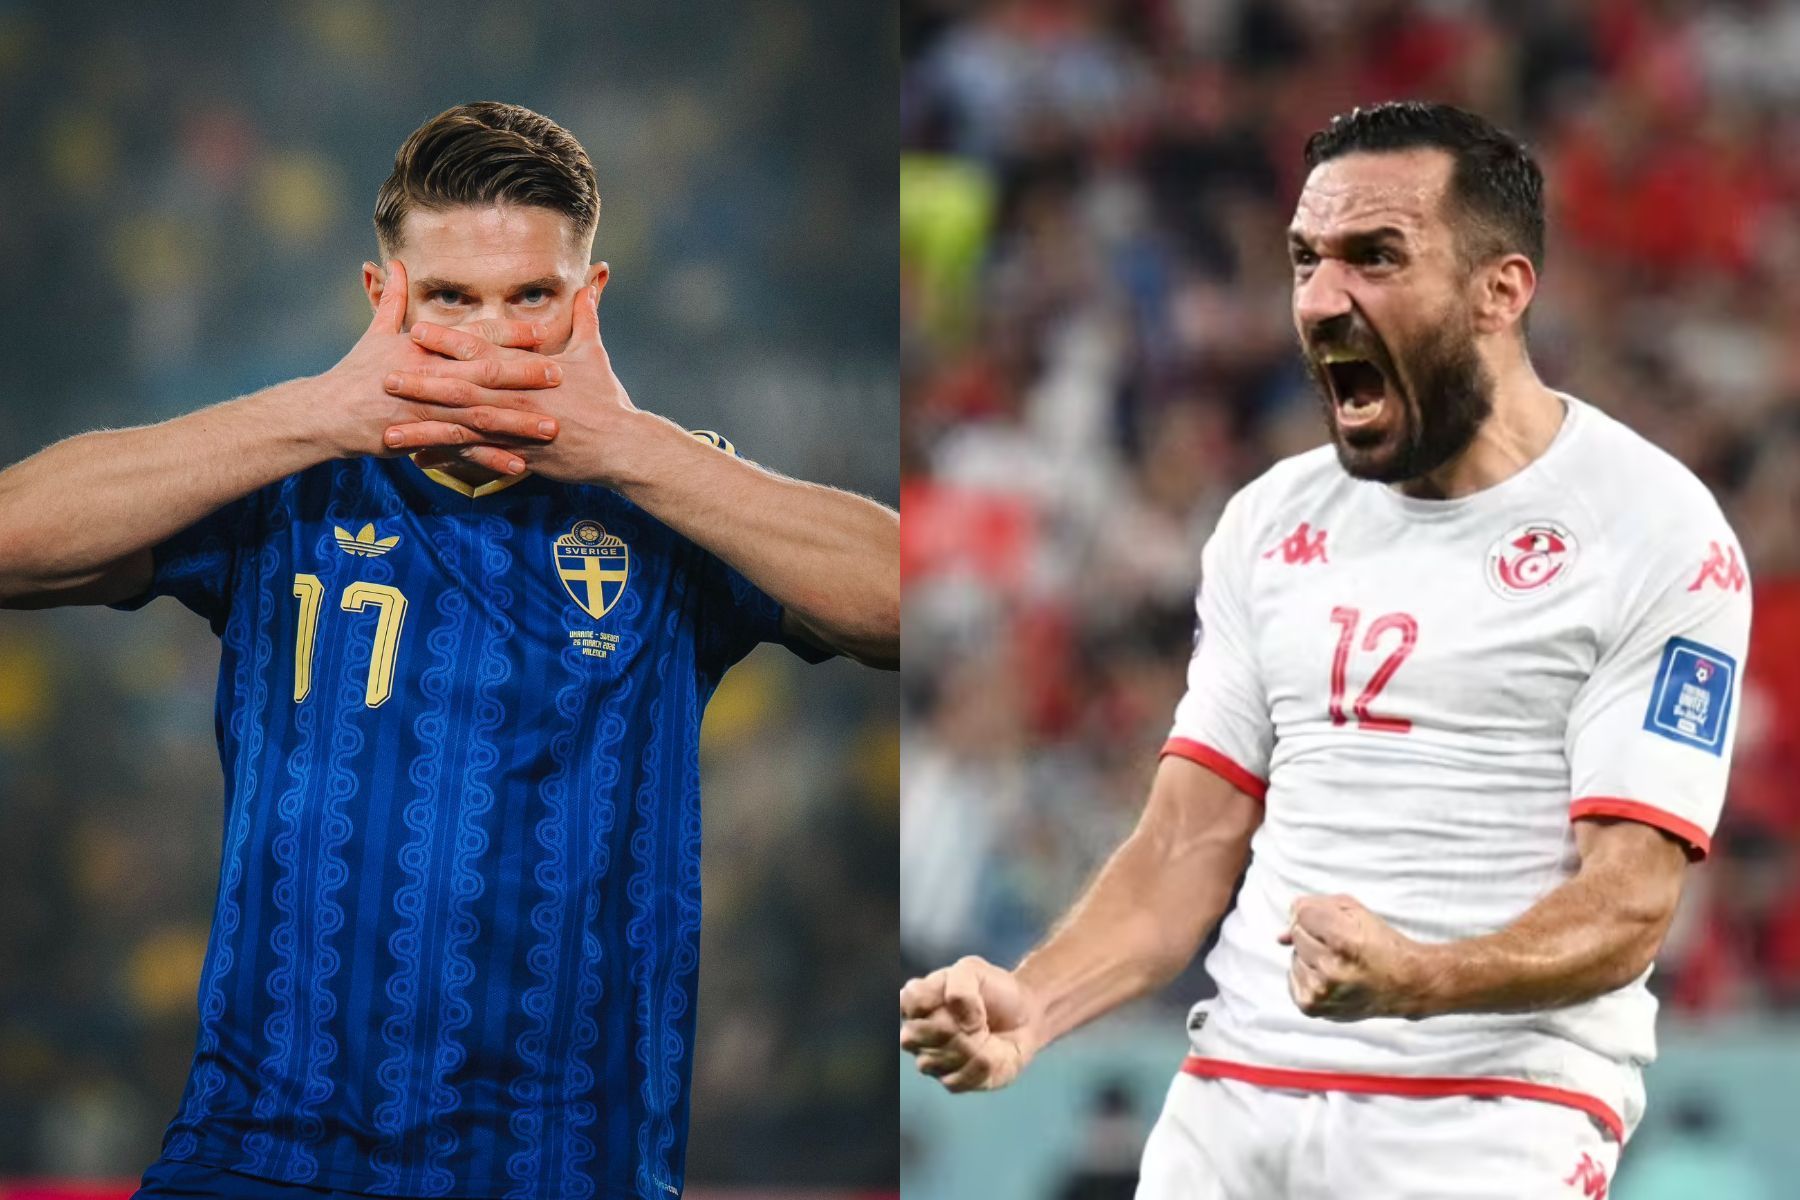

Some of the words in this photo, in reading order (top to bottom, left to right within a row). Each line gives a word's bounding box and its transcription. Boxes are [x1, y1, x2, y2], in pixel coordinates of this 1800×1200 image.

[565, 547, 617, 555] SVERIGE
[293, 573, 408, 708] 17
[600, 632, 619, 642] SWEDEN
[583, 639, 601, 648] MARCH
[603, 642, 615, 651] 2026
[583, 648, 606, 658] VALENCIA
[1329, 606, 1418, 733] 12
